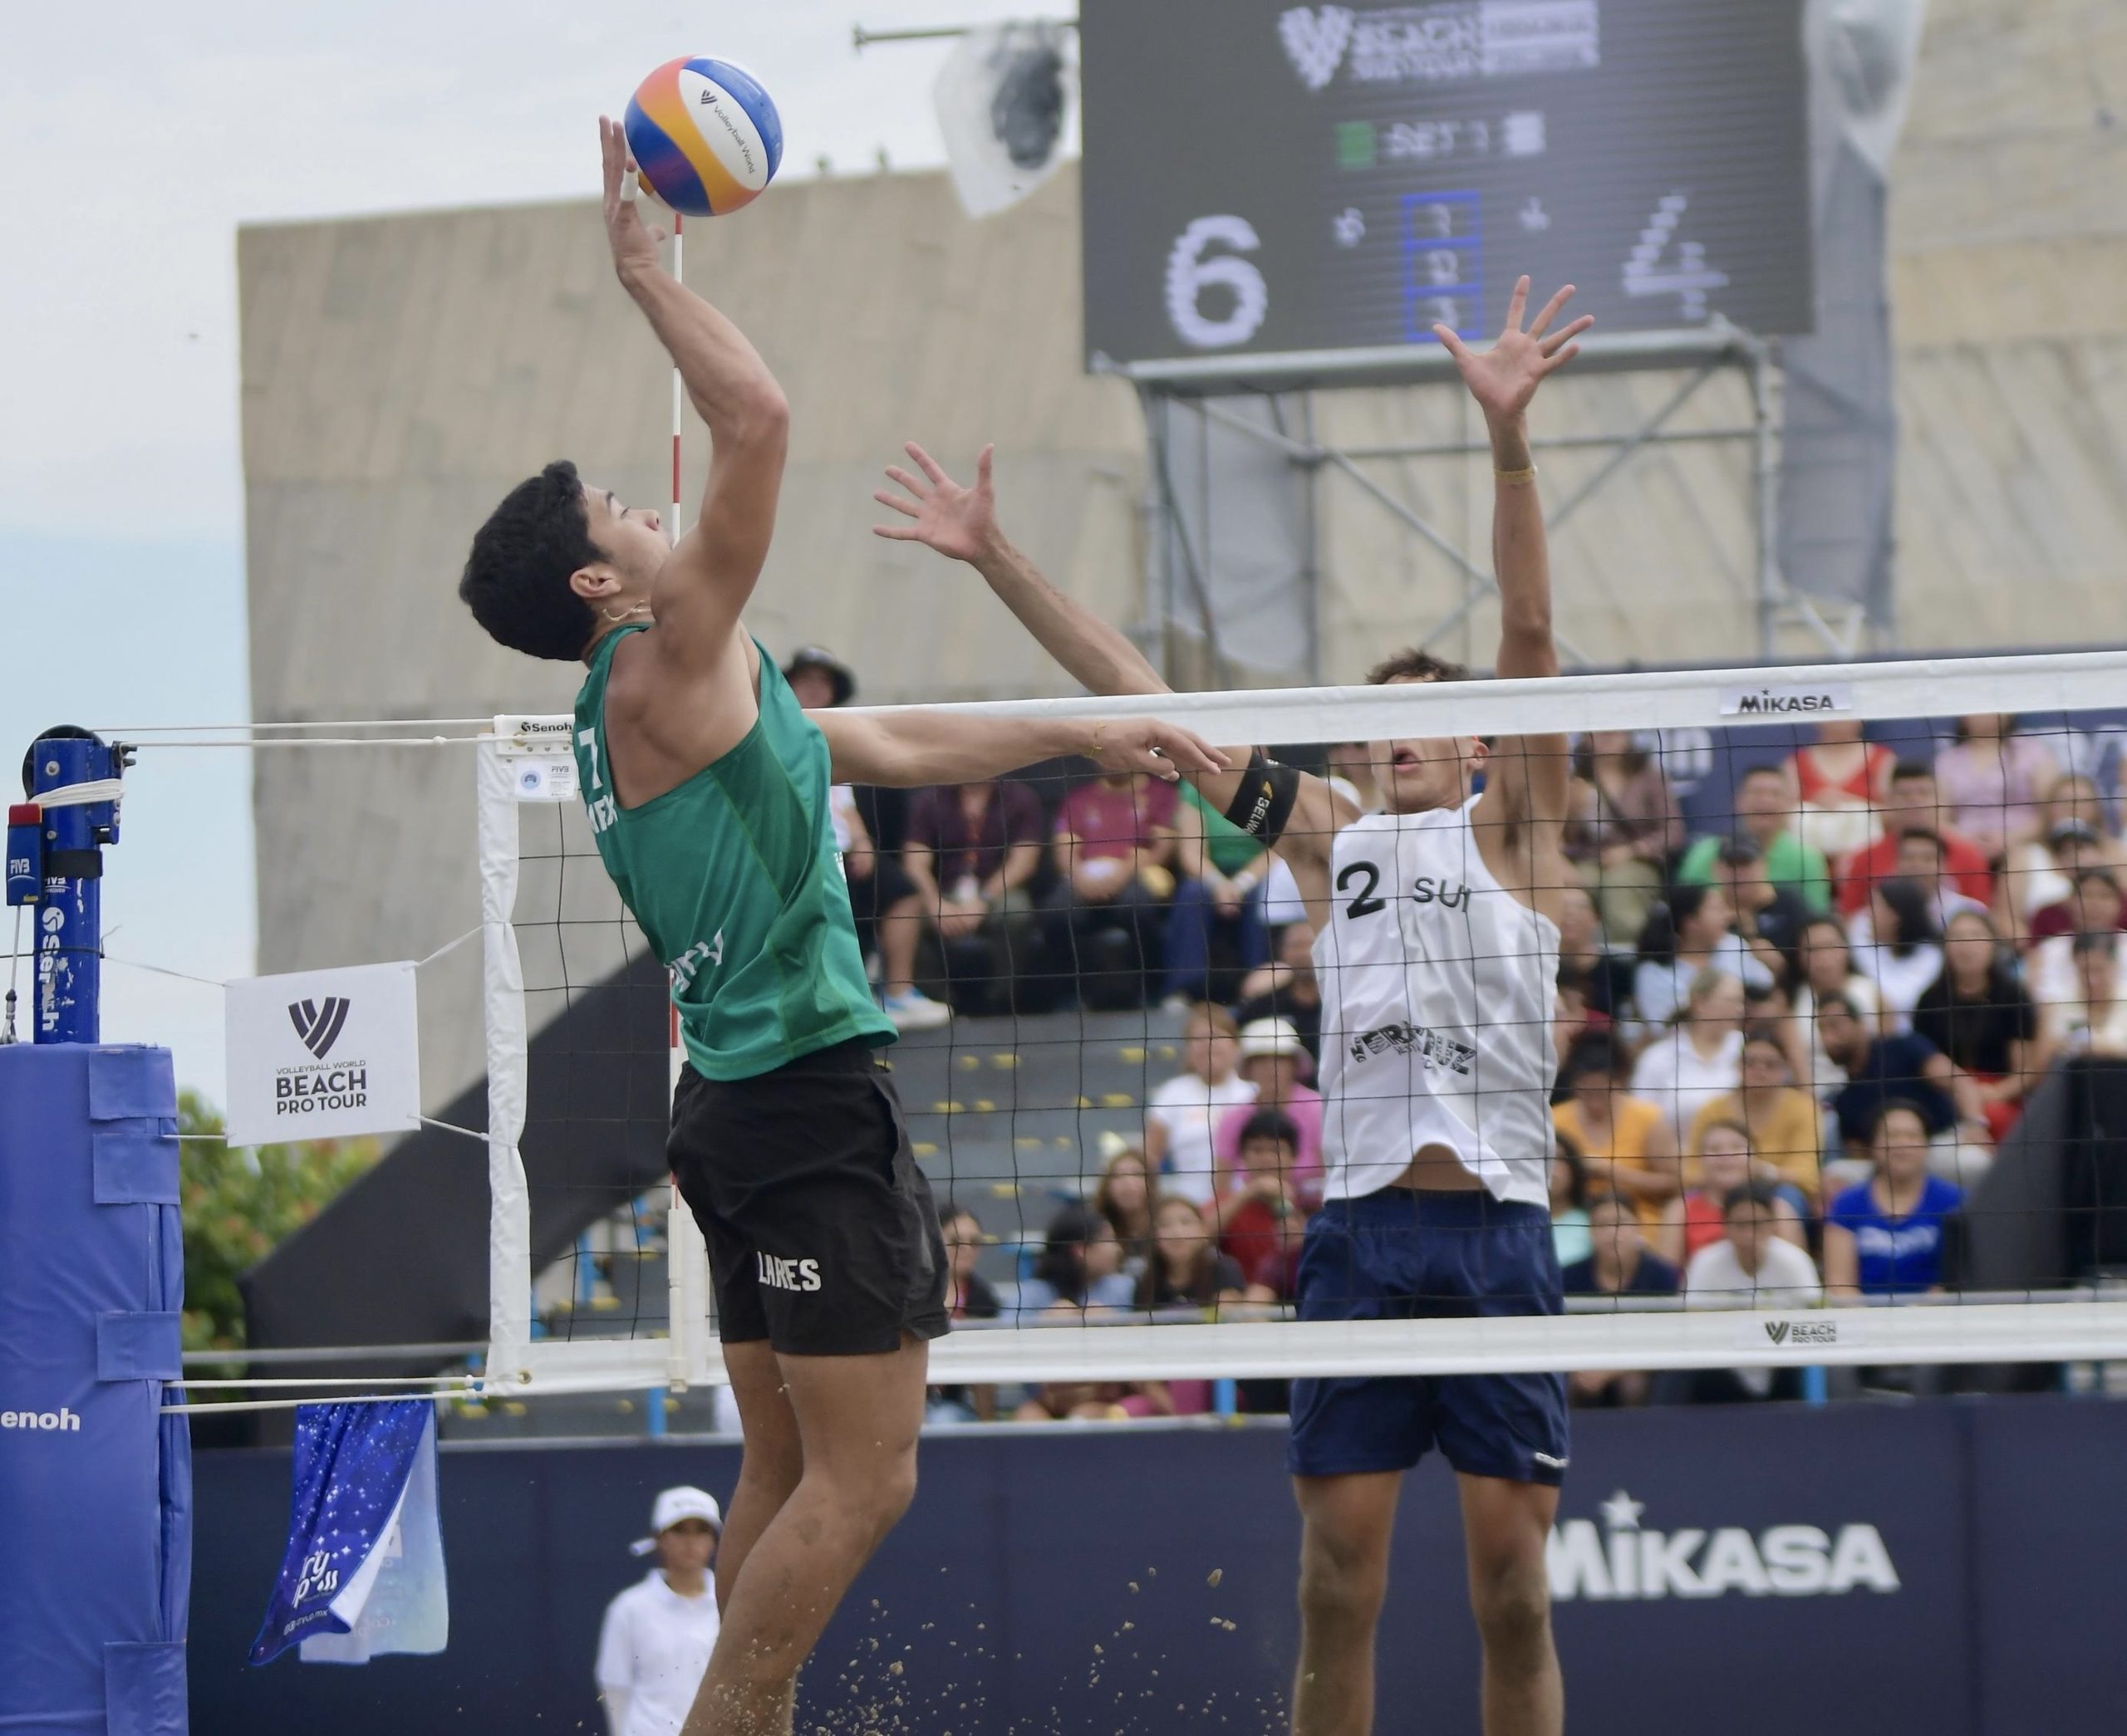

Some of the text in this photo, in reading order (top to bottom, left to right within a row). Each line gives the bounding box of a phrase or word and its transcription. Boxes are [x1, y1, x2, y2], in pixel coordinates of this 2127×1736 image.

[714, 105, 755, 174] Volleyball World
[1623, 192, 1731, 320] 4
[1167, 215, 1268, 347] 6
[532, 722, 572, 733] Senoh
[578, 727, 603, 789] 7
[10, 858, 31, 874] FIVB
[1336, 861, 1472, 919] 2 SUI
[276, 1060, 366, 1075] VOLLEYBALL WORLD
[276, 1069, 366, 1098] BEACH
[277, 1093, 366, 1115] PRO TOUR
[757, 1251, 822, 1292] LARES
[1792, 1325, 1835, 1336] BEACH
[1, 1407, 81, 1431] enoh
